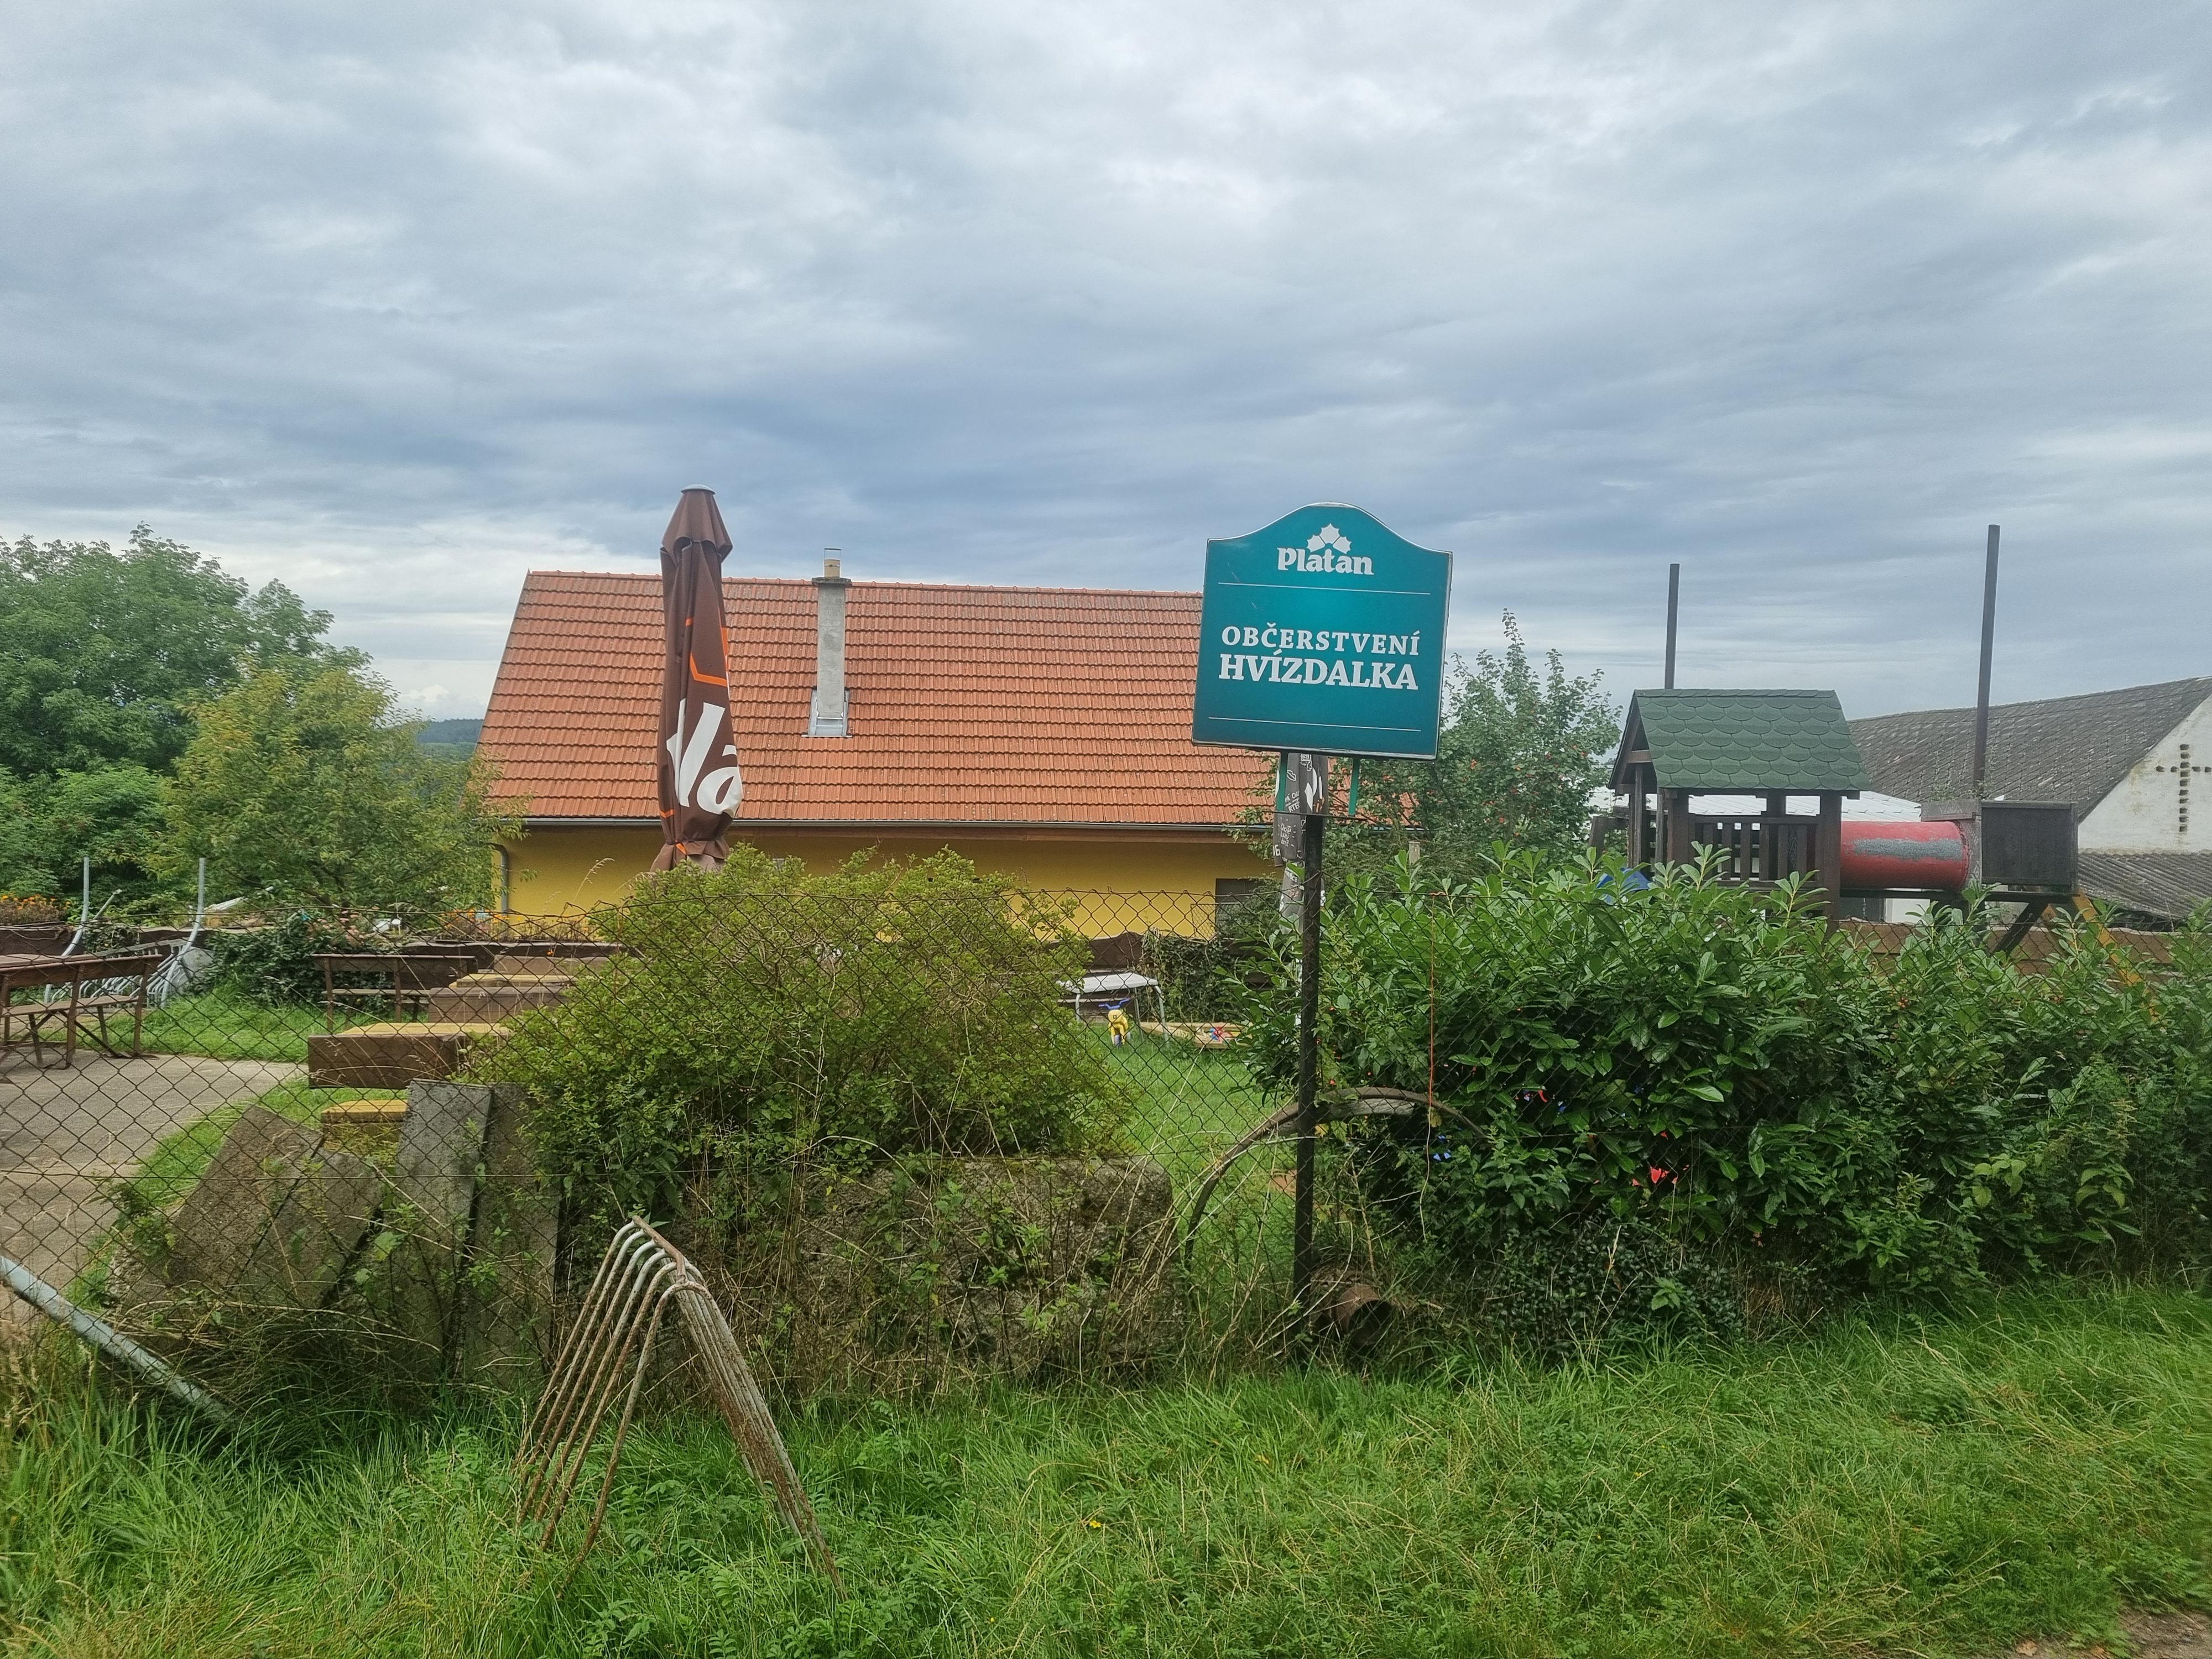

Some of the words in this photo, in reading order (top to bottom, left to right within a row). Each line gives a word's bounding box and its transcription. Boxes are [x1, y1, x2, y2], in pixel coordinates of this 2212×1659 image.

[1277, 547, 1374, 575] Platan
[1222, 622, 1420, 655] OBČERSTVENÍ
[1219, 649, 1418, 690] HVÍZDALKA
